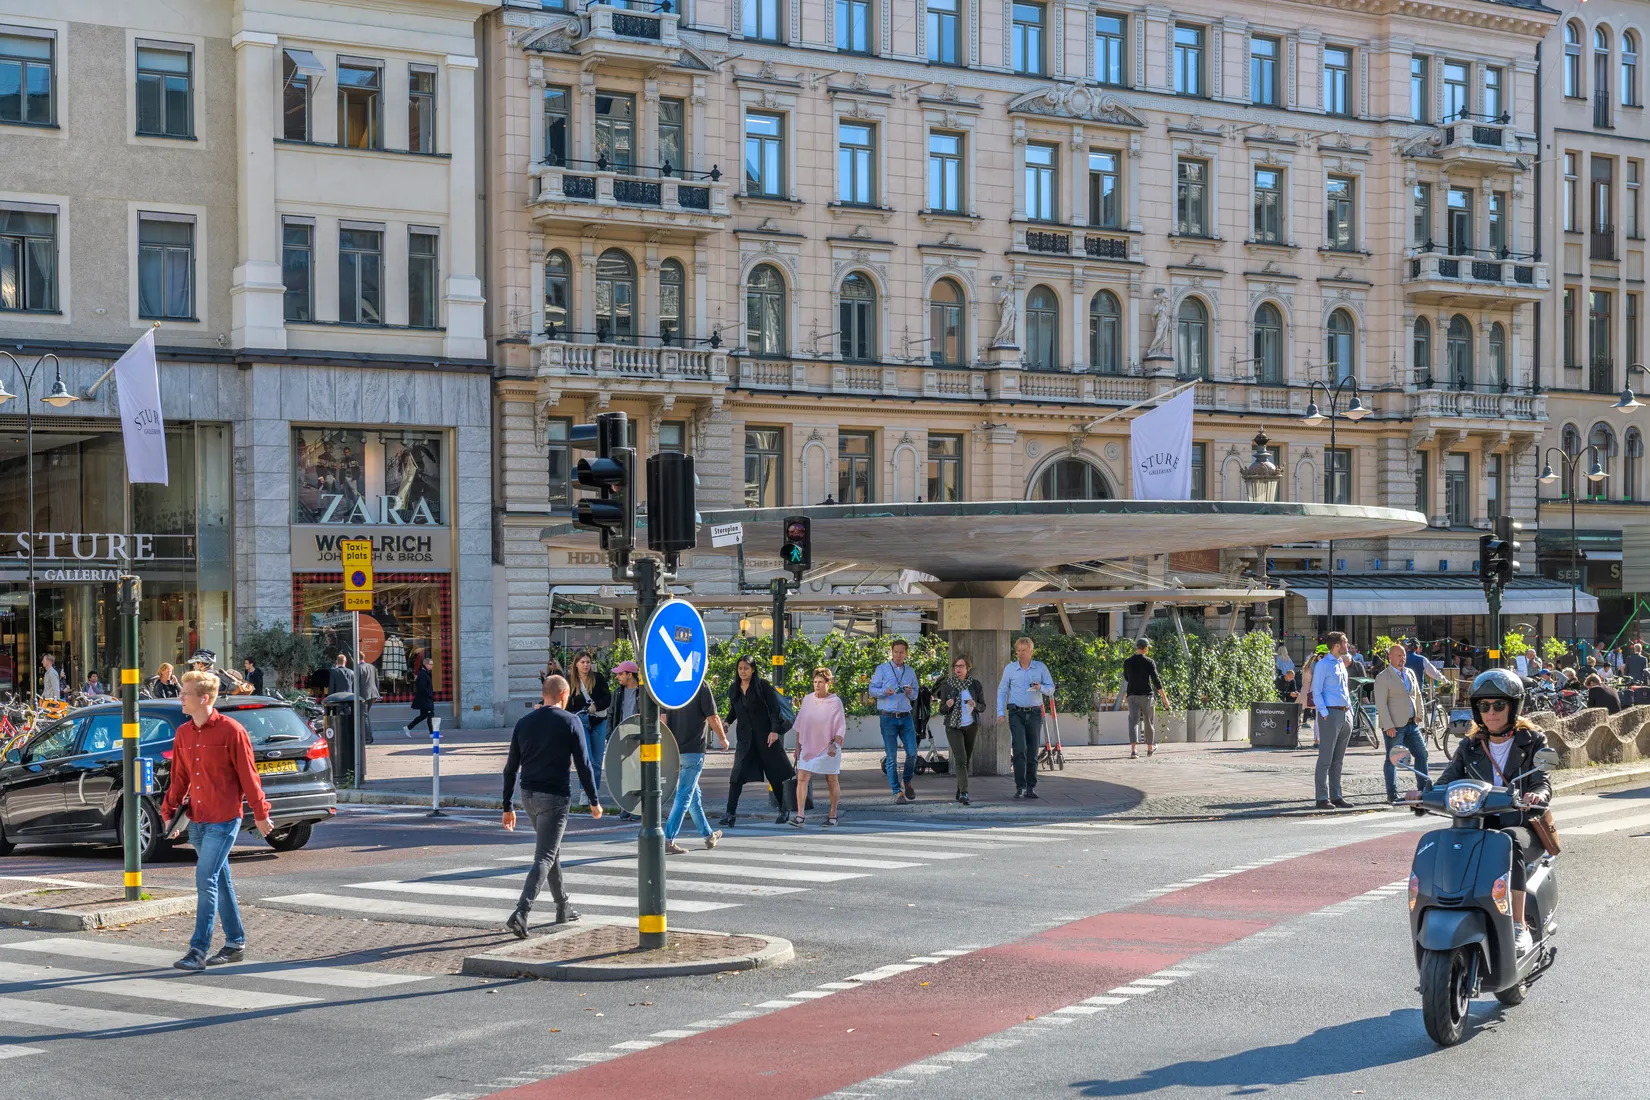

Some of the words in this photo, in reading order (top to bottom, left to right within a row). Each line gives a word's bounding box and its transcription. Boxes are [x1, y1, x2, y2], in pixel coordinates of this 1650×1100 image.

[1141, 453, 1179, 473] STURE
[320, 493, 439, 525] ZARA
[714, 525, 739, 535] Stureplan
[16, 531, 155, 561] STURE
[346, 543, 368, 551] Taxi-
[317, 552, 342, 561] JOH
[386, 552, 394, 561] &
[398, 553, 433, 562] BROS.
[346, 552, 368, 561] plats
[1557, 570, 1581, 580] SEB
[276, 761, 293, 772] 620
